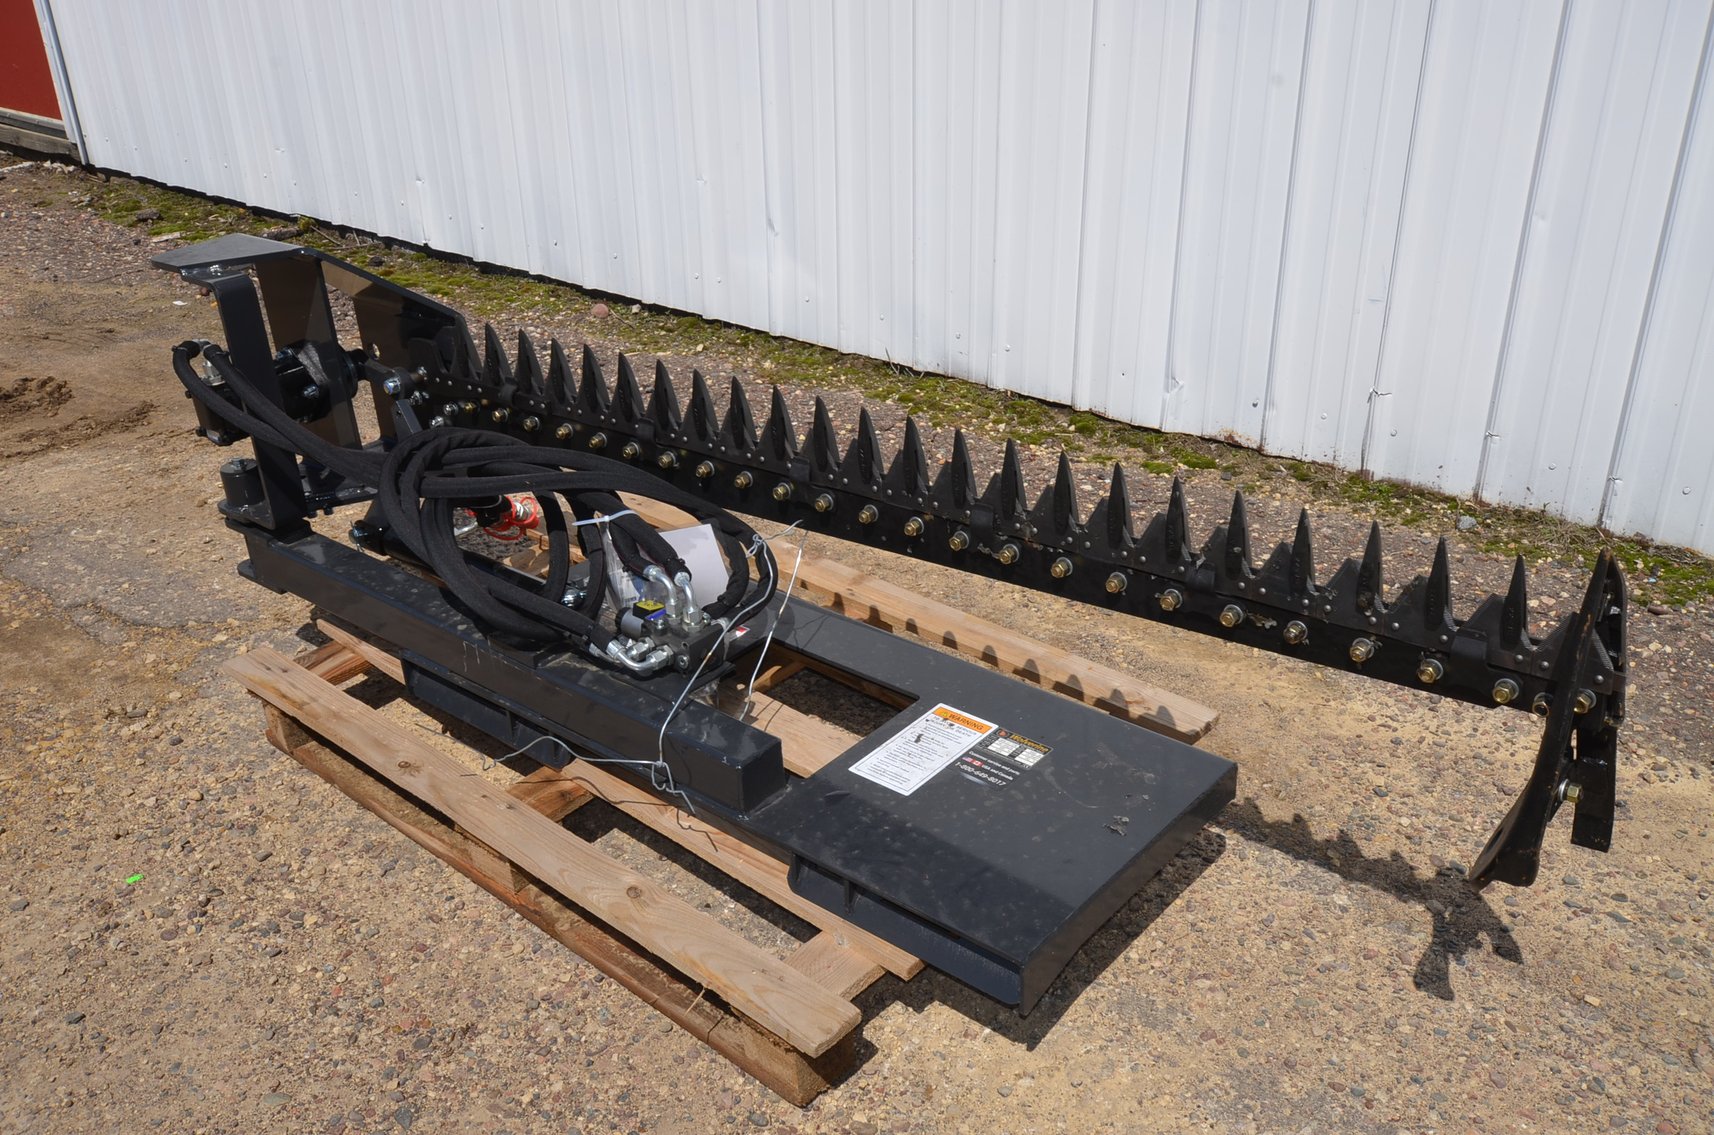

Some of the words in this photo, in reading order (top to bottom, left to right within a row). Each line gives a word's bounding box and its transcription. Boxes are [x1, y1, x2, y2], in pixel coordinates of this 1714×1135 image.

[948, 714, 984, 731] WARNING
[987, 759, 1001, 767] service
[955, 762, 1007, 786] 1-800-649-8017
[998, 771, 1013, 781] Canada
